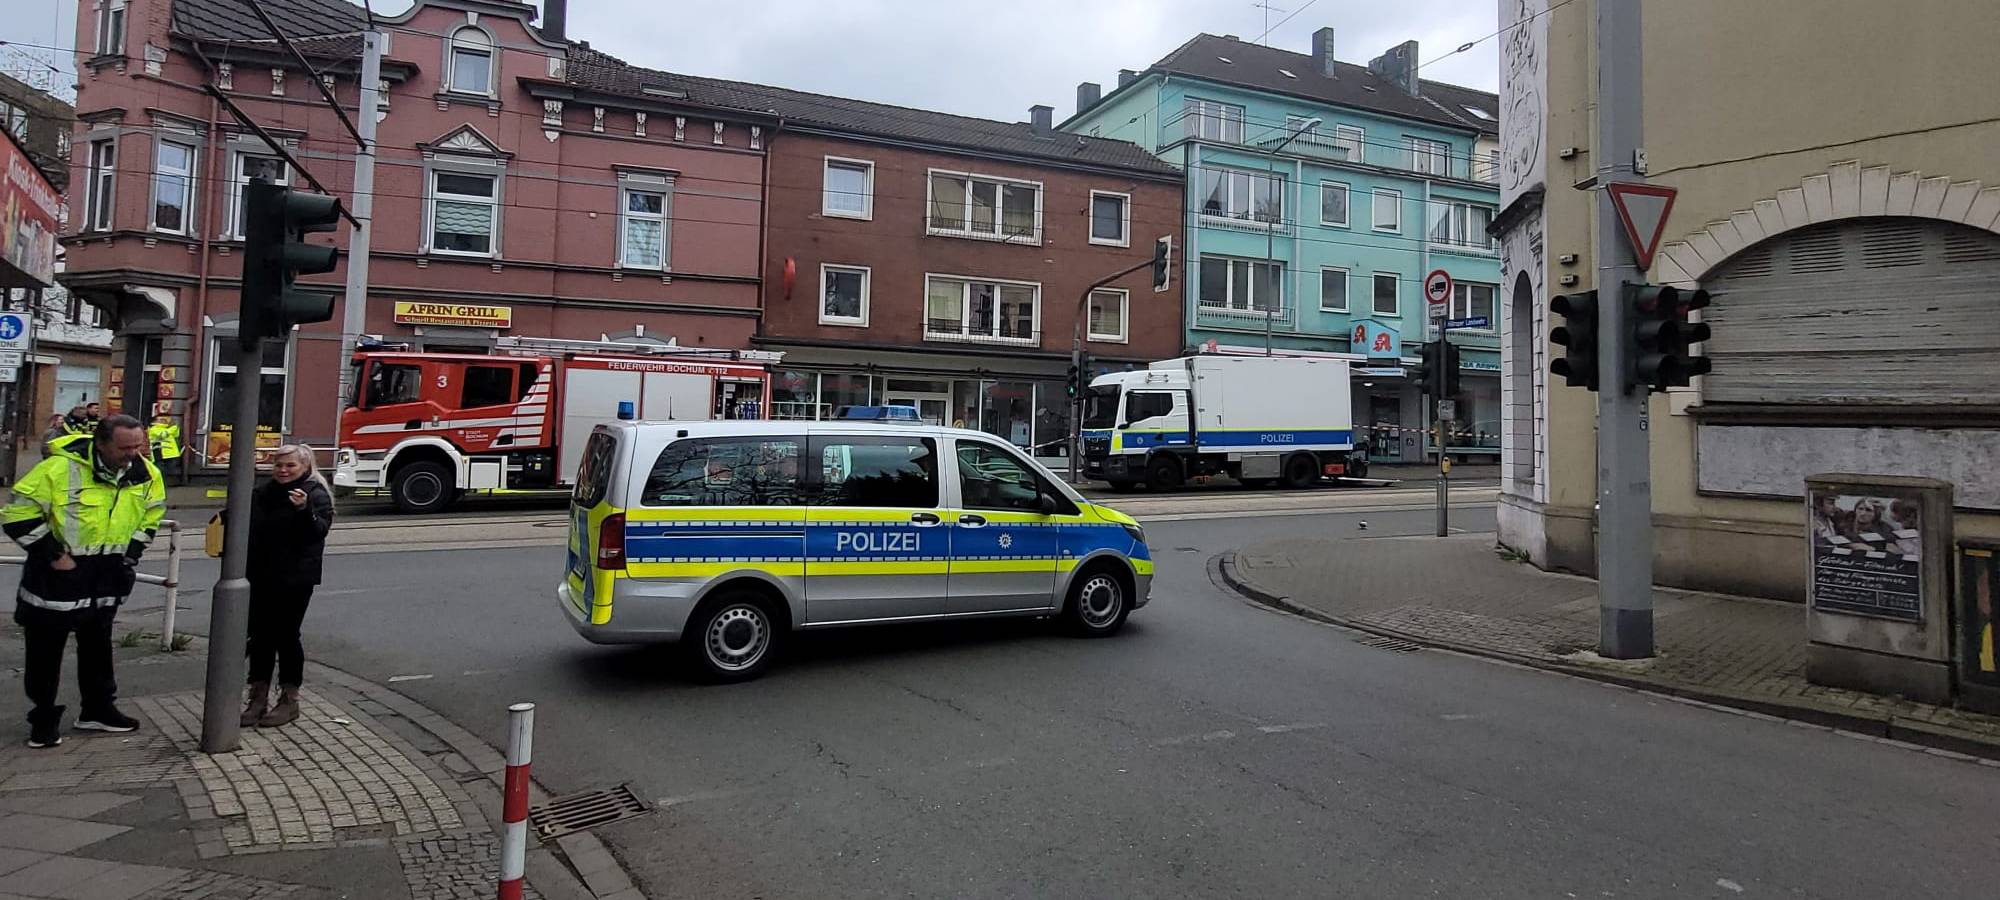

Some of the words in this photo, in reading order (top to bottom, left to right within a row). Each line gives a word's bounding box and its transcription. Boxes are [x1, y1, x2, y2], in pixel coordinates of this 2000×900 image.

[407, 303, 452, 315] AFRIN
[456, 306, 499, 317] GRILL
[608, 362, 664, 372] FEUERWEHR
[666, 365, 705, 374] BOCHUM
[437, 375, 448, 388] 3
[1260, 433, 1294, 443] POLIZEI
[837, 532, 920, 551] POLIZEI
